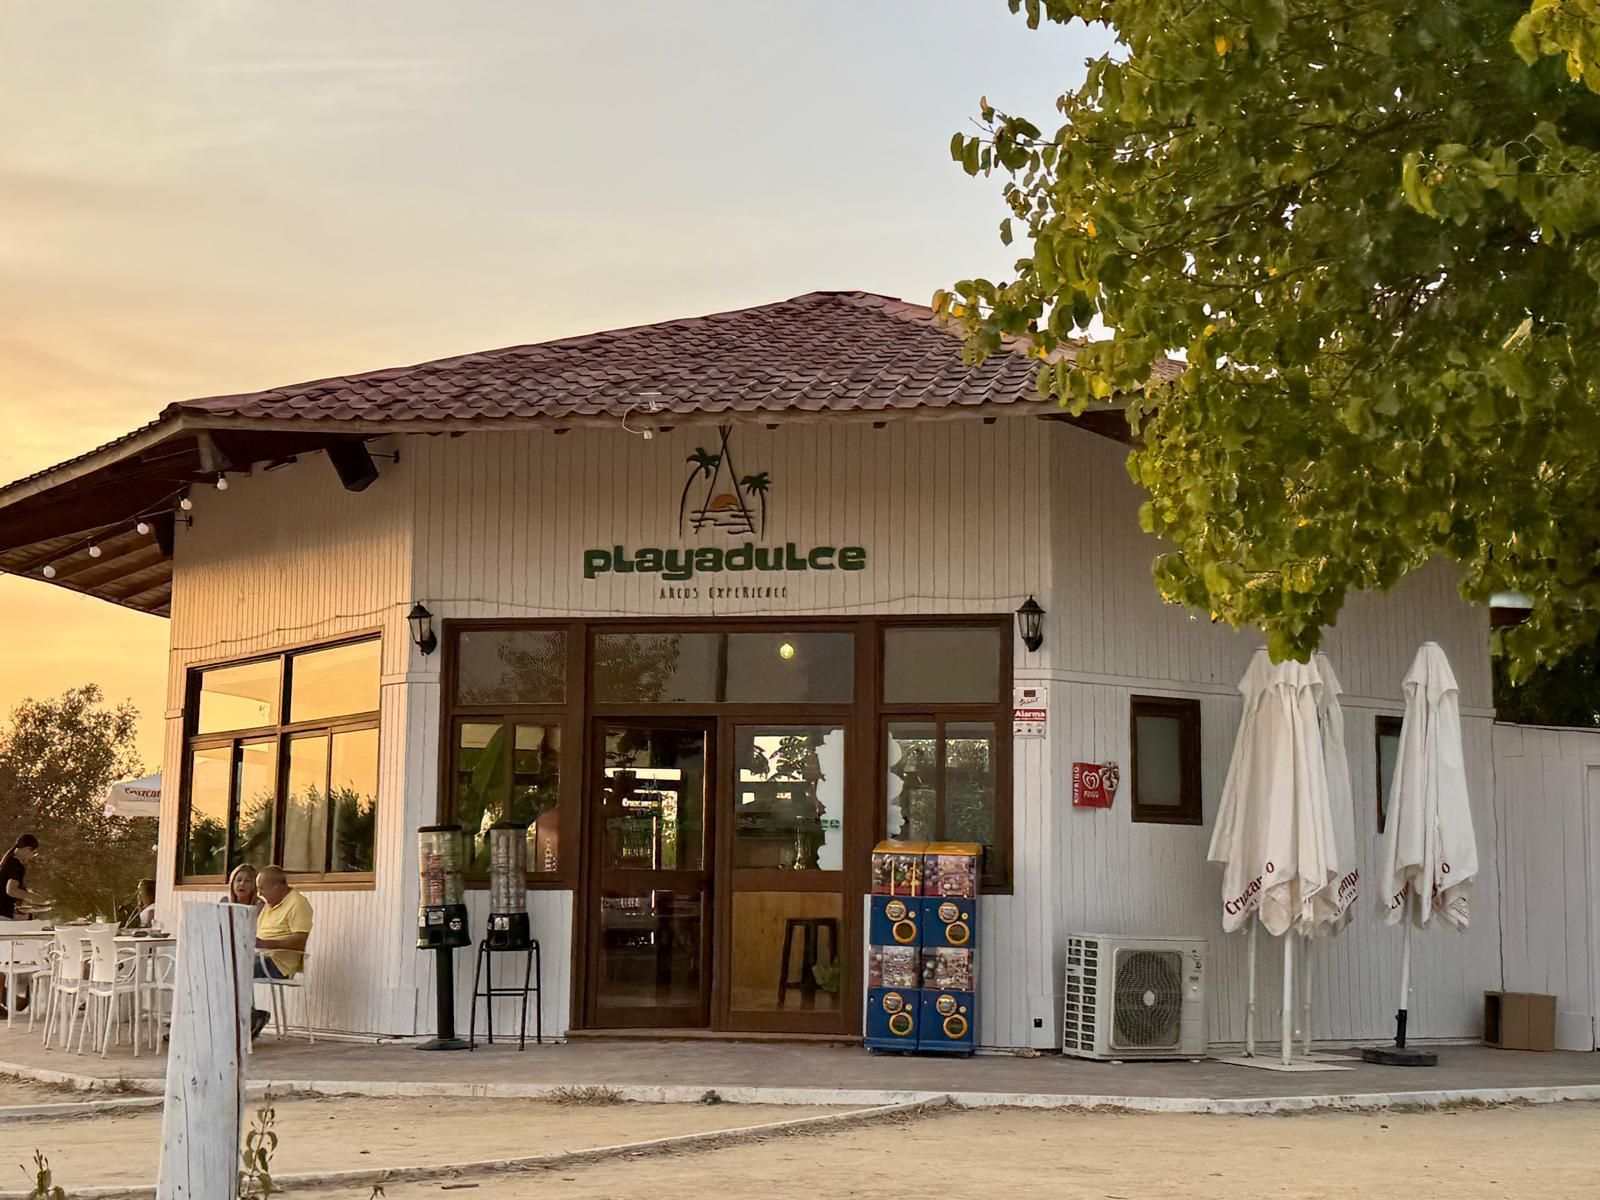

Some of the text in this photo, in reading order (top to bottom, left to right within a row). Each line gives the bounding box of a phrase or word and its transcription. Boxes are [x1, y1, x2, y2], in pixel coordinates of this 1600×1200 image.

[659, 586, 788, 600] ARCOS EXPERIENCE
[1014, 709, 1046, 718] Alarma
